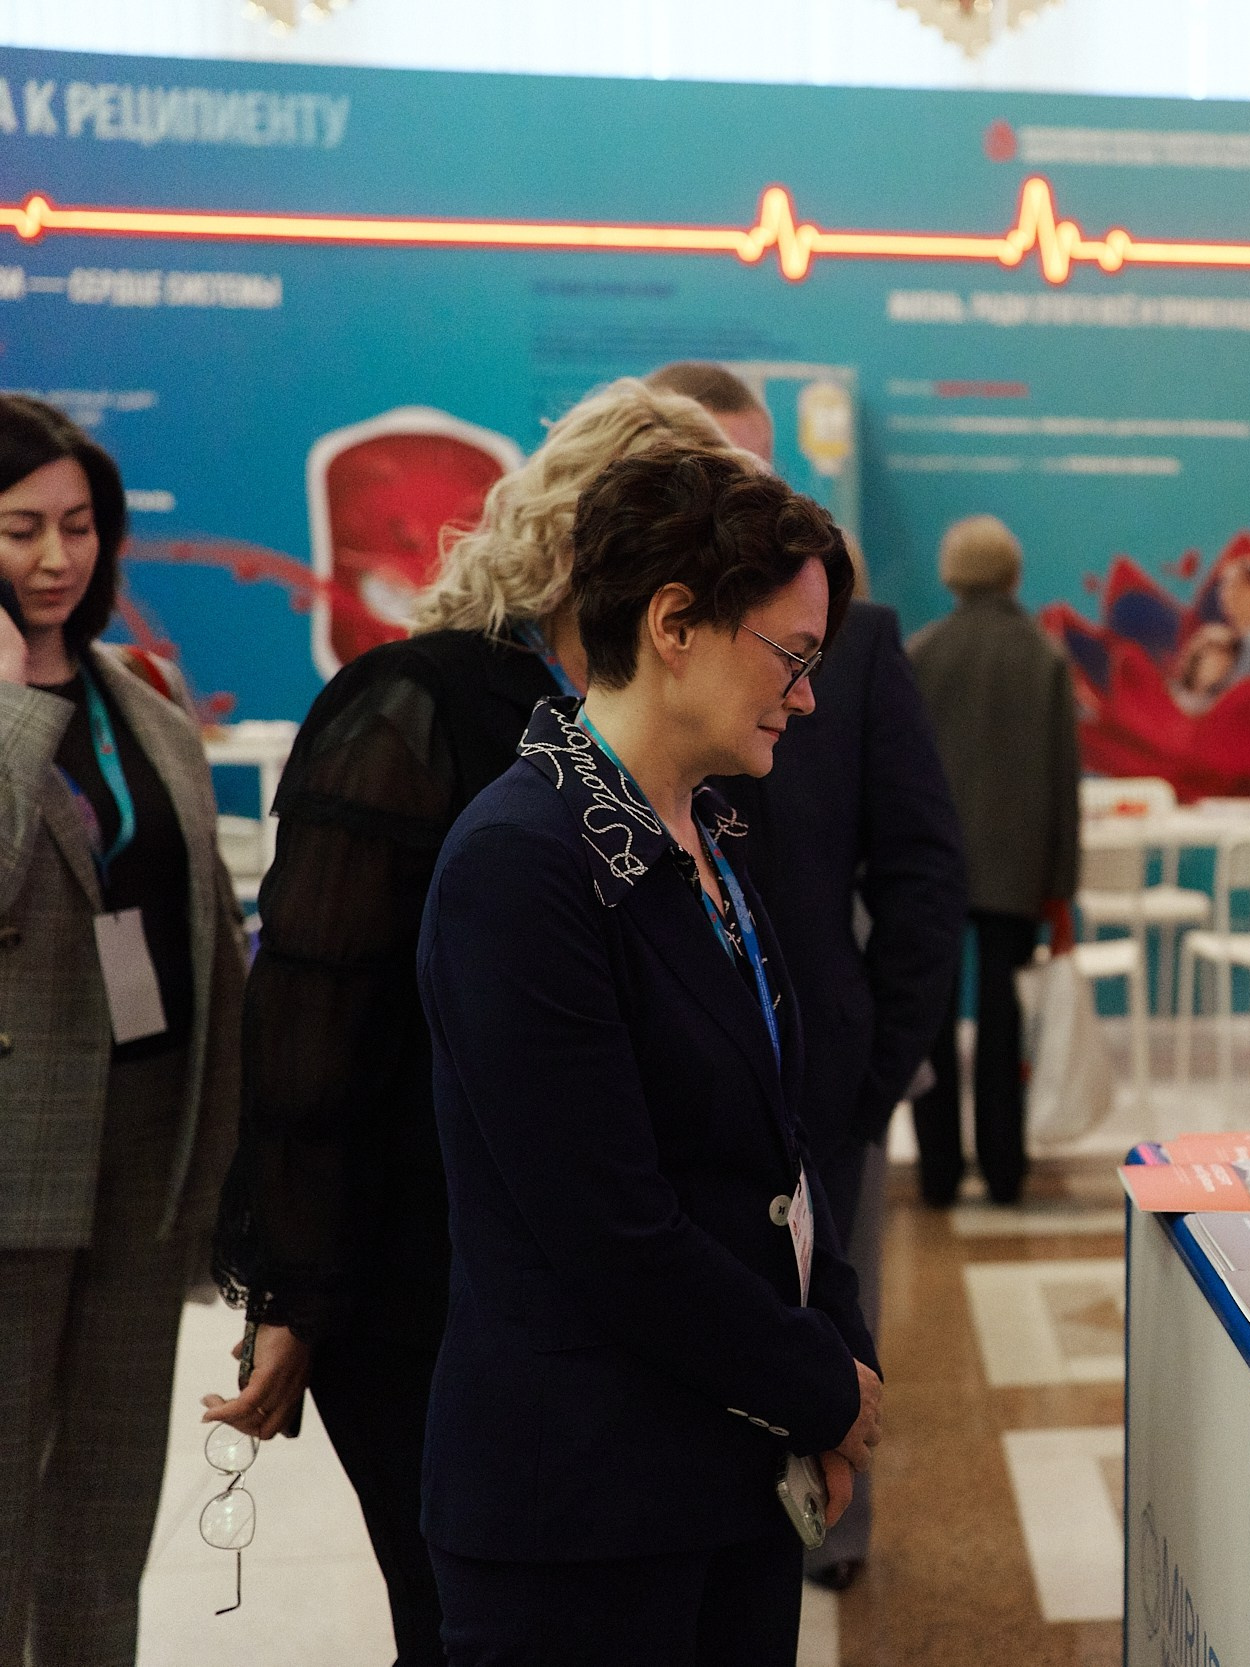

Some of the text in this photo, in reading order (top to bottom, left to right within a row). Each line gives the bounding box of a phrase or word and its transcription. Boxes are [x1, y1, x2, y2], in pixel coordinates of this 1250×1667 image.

[23, 78, 58, 137] К
[66, 82, 351, 150] РЕЦИПИЕНТУ
[1162, 1537, 1220, 1667] MIRU
